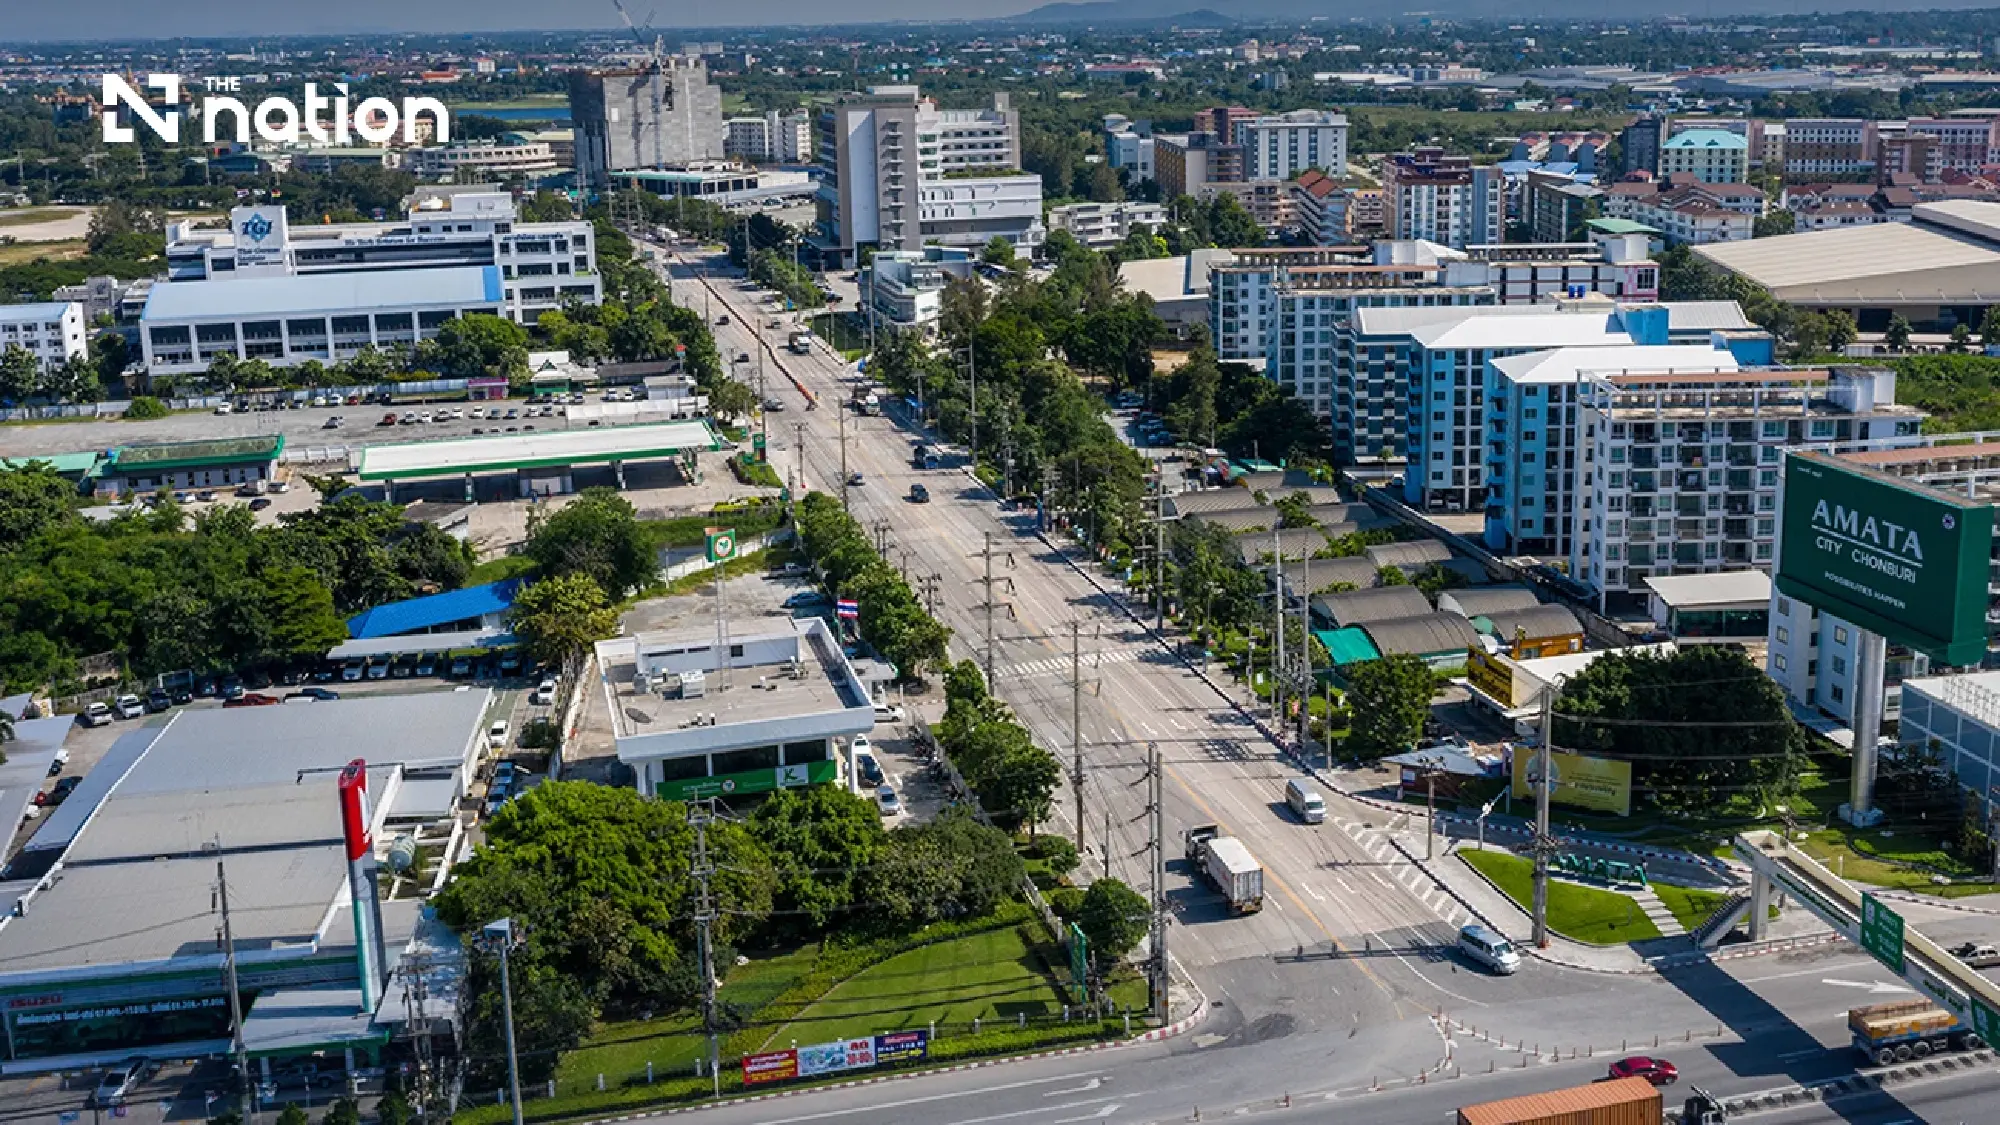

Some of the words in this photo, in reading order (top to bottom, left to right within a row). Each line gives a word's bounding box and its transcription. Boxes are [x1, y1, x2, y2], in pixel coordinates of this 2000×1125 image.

[1811, 499, 1924, 560] AMATA
[1815, 535, 1843, 555] CITY
[1851, 548, 1917, 584] CHONBURI
